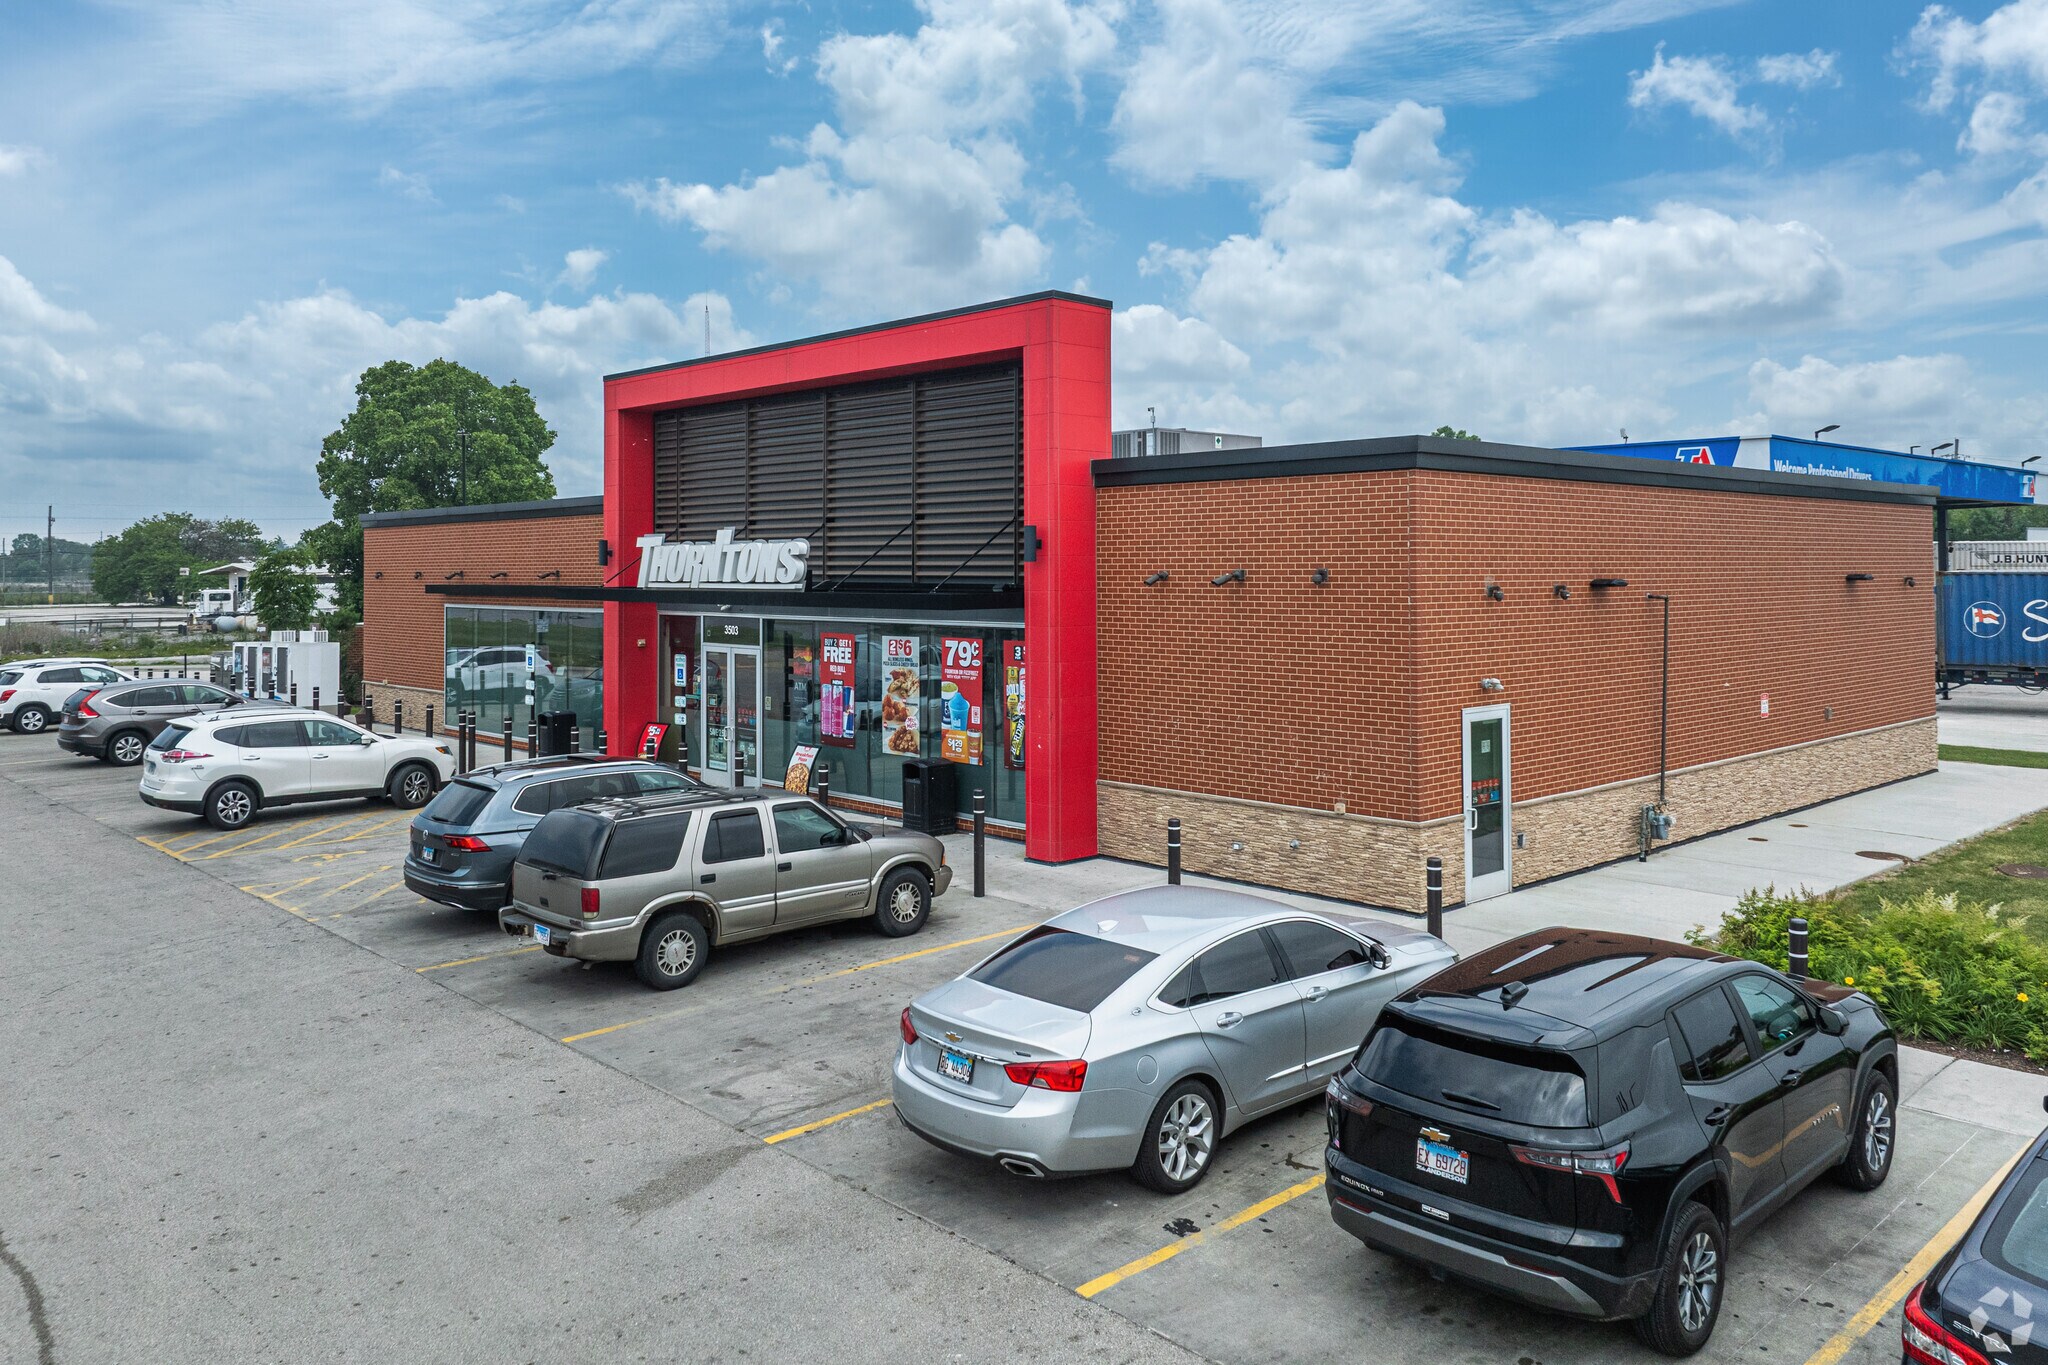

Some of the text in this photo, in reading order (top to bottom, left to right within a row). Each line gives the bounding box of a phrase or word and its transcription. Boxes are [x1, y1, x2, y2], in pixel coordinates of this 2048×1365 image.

[1774, 459, 1872, 481] Welcome Professional Drivers
[724, 625, 739, 635] 3503
[824, 638, 834, 646] BUY
[839, 639, 848, 647] GET
[889, 640, 896, 650] 2
[1014, 646, 1022, 656] 3
[824, 646, 852, 664] FREE
[794, 682, 807, 690] ATM
[1417, 1147, 1467, 1176] EX 69728
[1340, 1174, 1370, 1192] EQUINOX
[1426, 1167, 1467, 1185] ANDERSON
[1953, 1320, 2012, 1354] SENTRA
